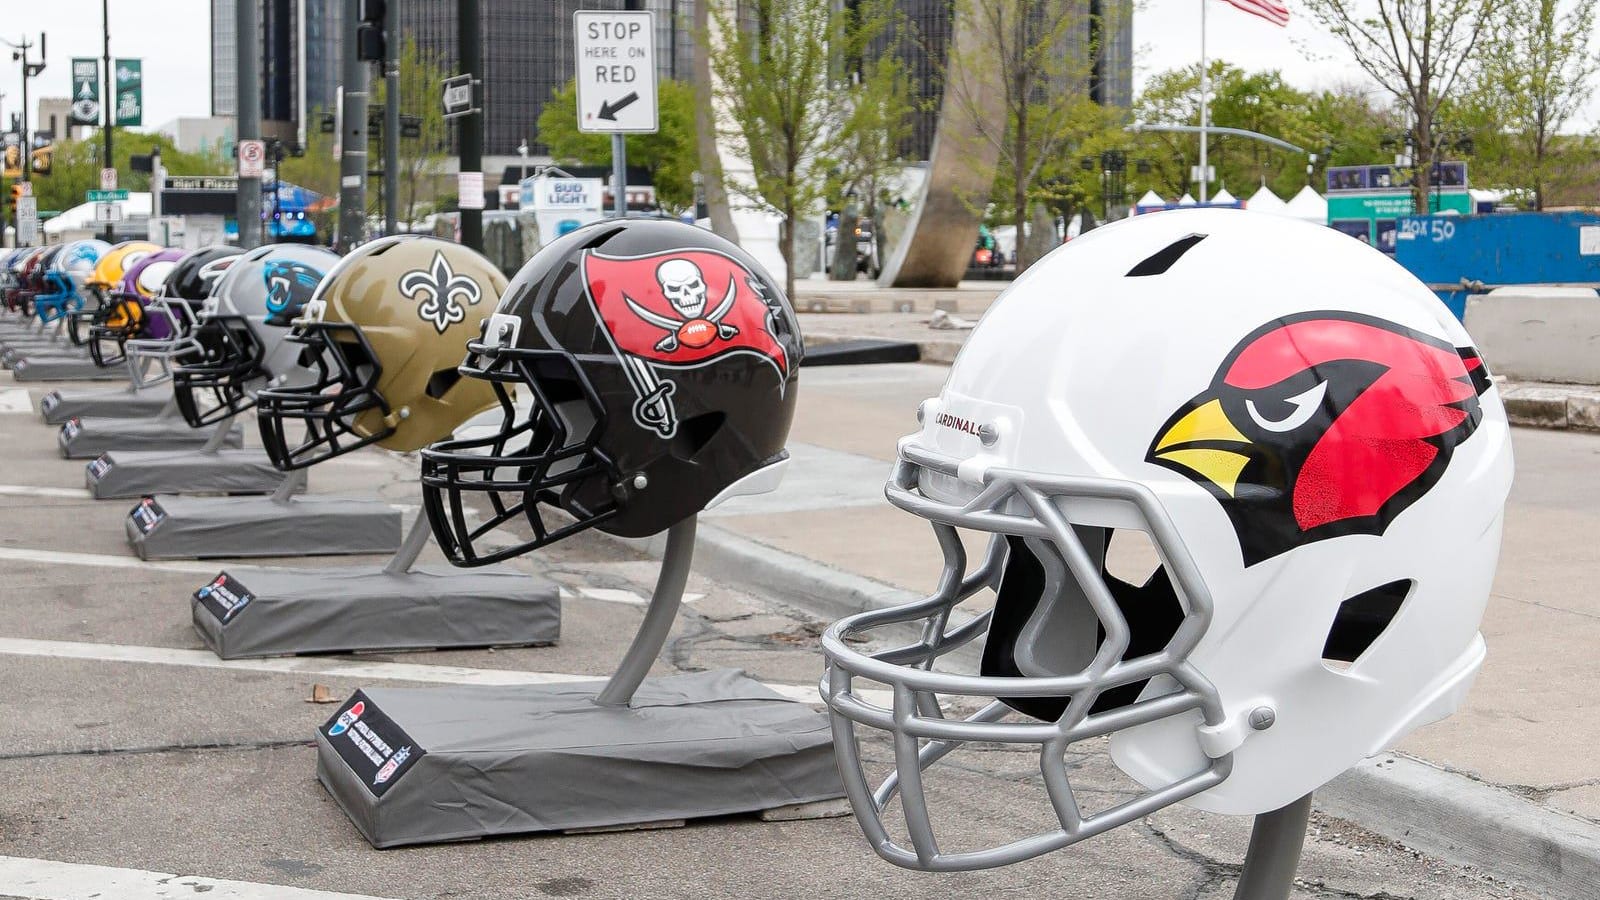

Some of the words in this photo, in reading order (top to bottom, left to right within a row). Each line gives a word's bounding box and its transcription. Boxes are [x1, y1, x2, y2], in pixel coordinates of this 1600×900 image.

[588, 22, 641, 39] STOP
[585, 47, 617, 58] HERE
[628, 47, 646, 58] ON
[596, 65, 636, 83] RED
[555, 183, 582, 192] BUD
[549, 194, 588, 204] LIGHT
[1432, 219, 1456, 242] 50
